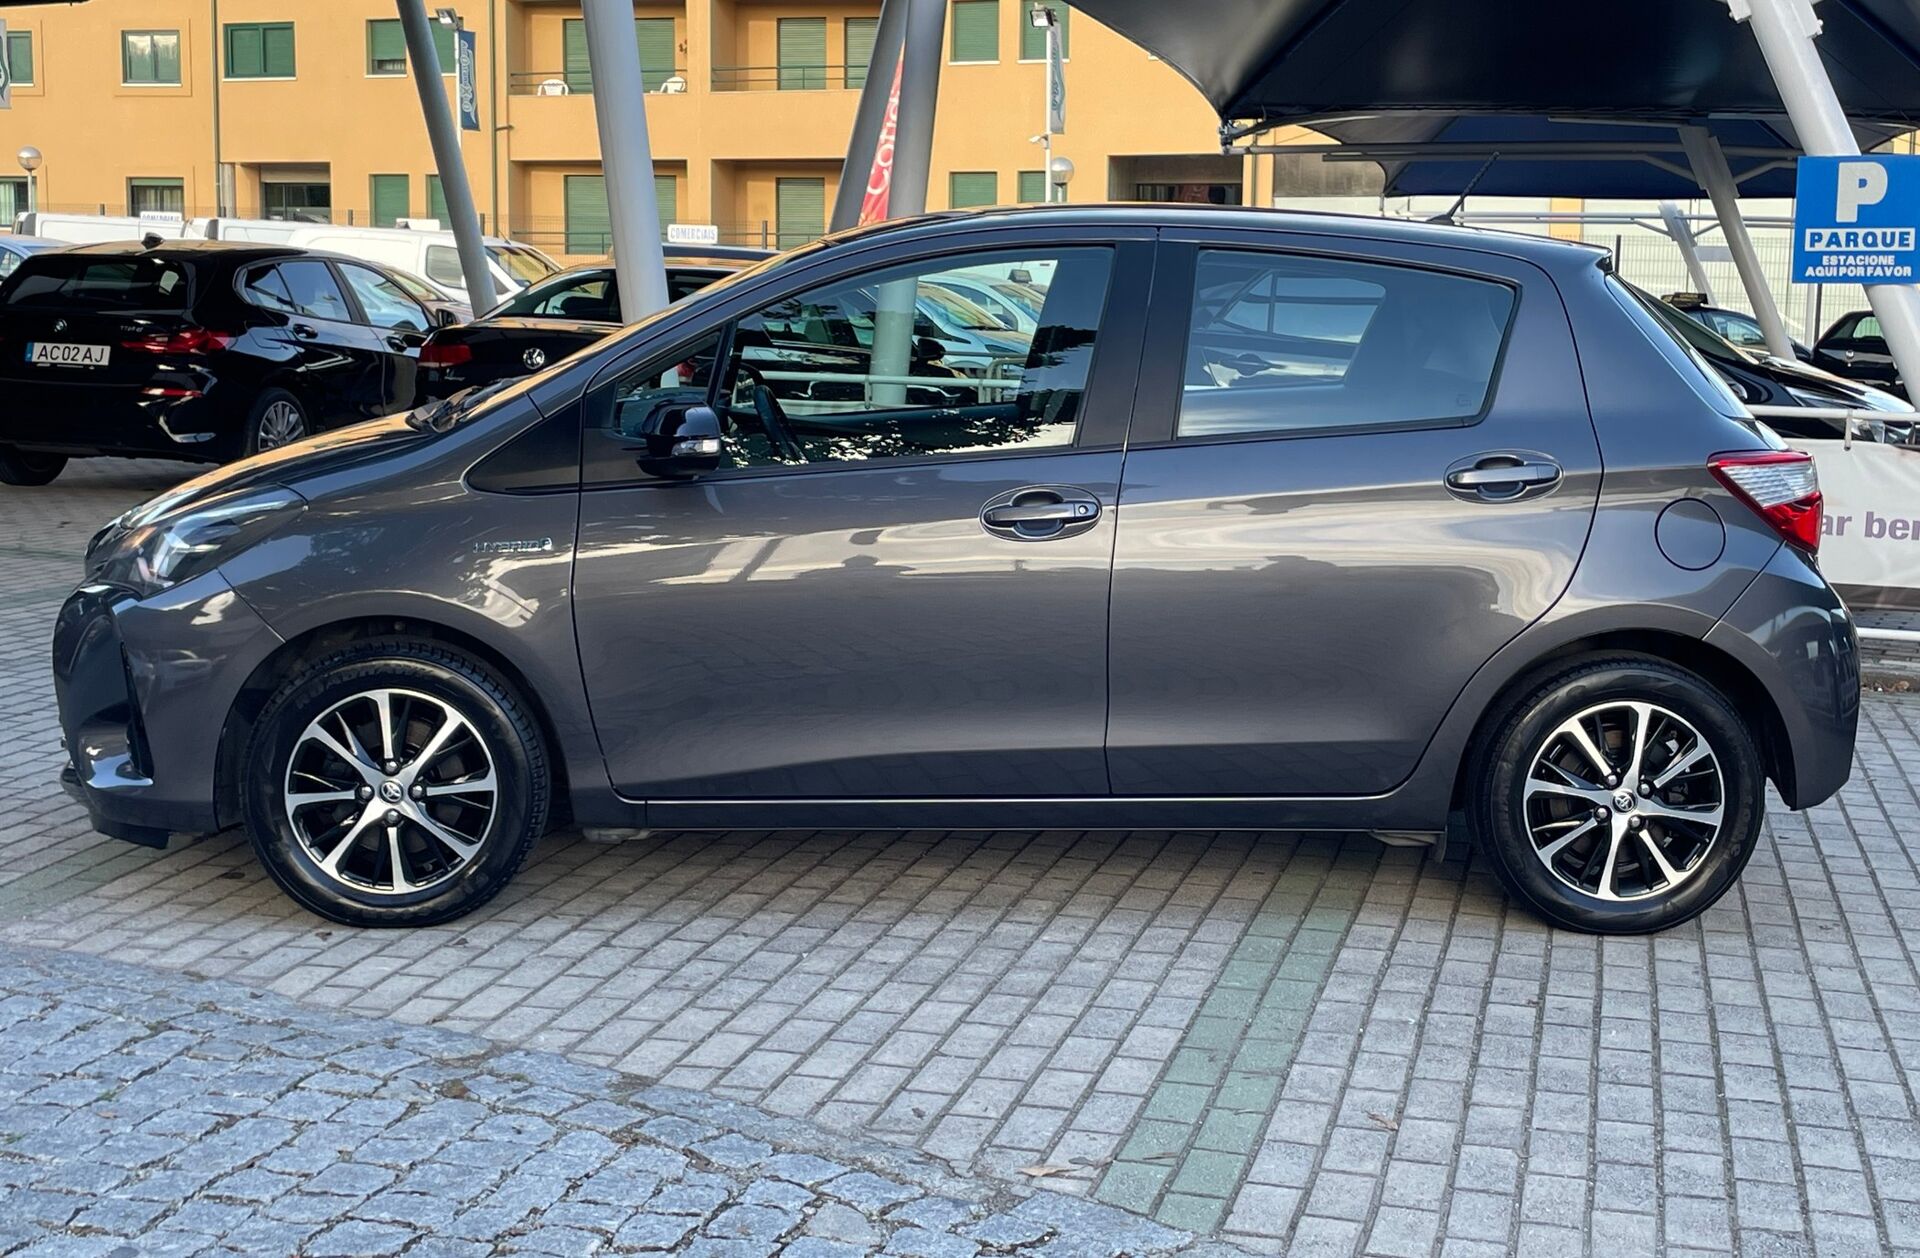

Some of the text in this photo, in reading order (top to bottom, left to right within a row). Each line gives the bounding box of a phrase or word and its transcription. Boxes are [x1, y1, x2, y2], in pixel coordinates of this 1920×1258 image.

[1836, 162, 1888, 223] P
[1809, 231, 1911, 248] PARQUE
[1822, 255, 1895, 266] ESTACIONE
[1805, 266, 1912, 277] AQUI POR FAVOR
